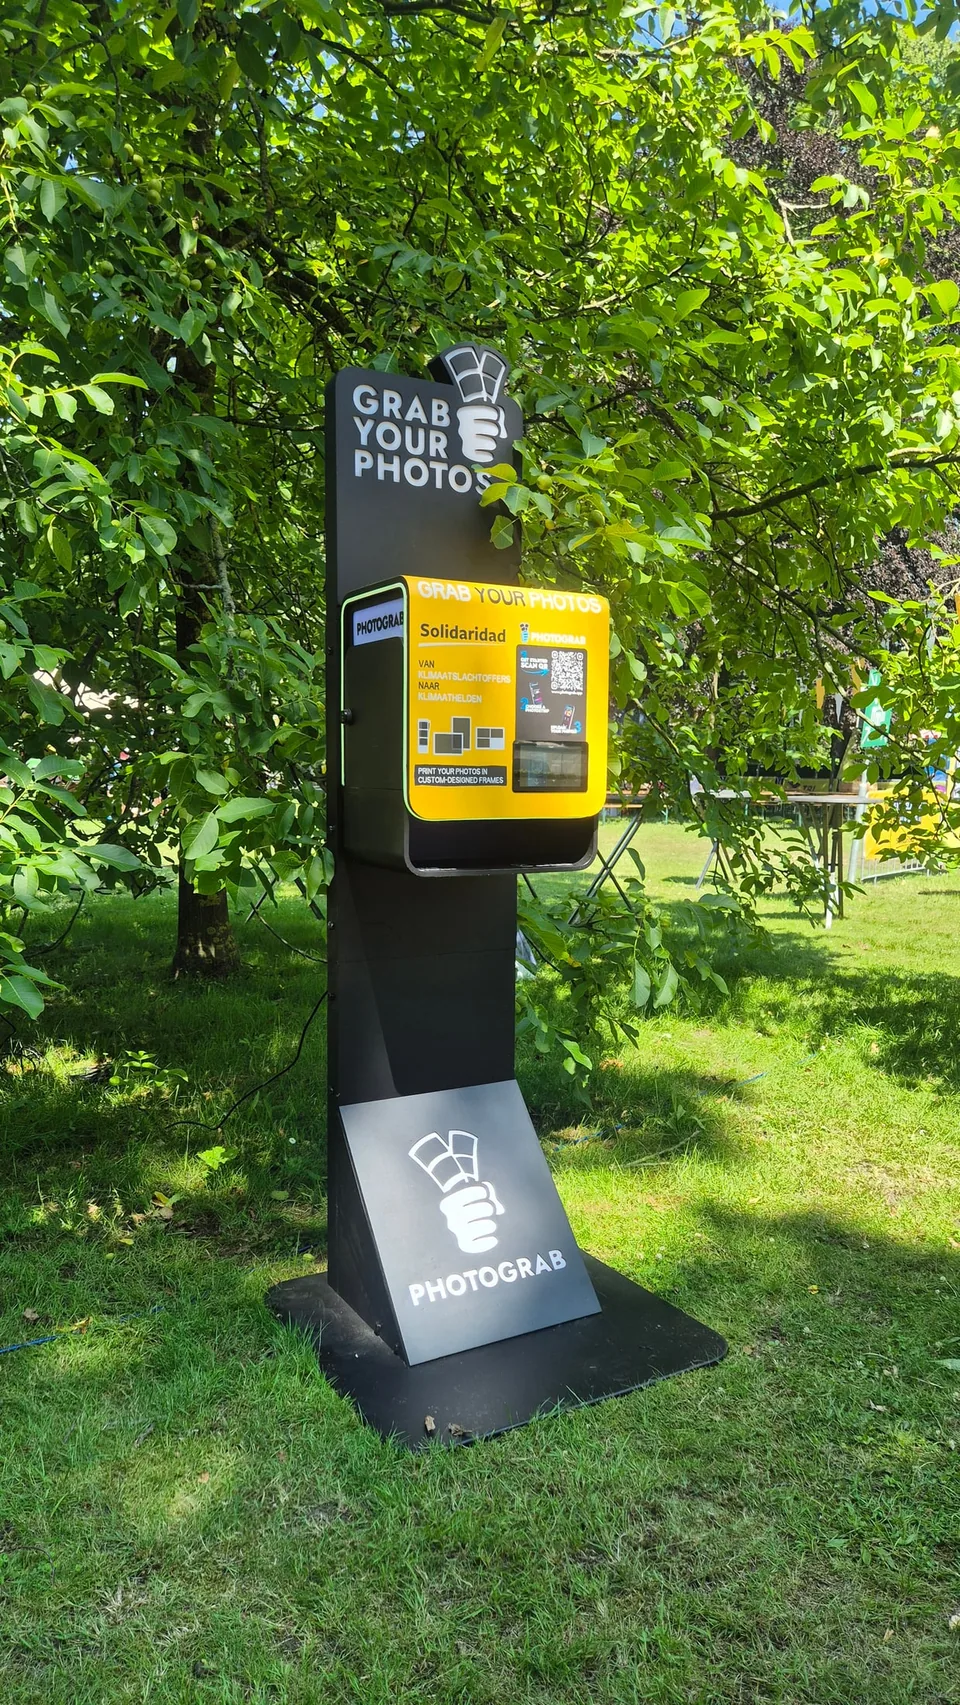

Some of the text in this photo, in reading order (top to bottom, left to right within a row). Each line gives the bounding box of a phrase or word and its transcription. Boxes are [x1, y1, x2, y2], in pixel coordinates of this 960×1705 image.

[353, 384, 451, 428] GRAB
[353, 416, 448, 459] YOUR
[354, 449, 492, 496] PHOTOS
[417, 580, 602, 614] GRAB YOUR PHOTOS
[420, 623, 506, 643] Solidaridad
[530, 632, 586, 645] PHOTOGRAB
[418, 659, 435, 669] VAN
[417, 671, 511, 684] KLIMAATSLACHTOFFERS
[418, 681, 440, 690] NAAR
[417, 692, 482, 704] KLIMAATHELDEN
[417, 767, 437, 775] PRINT
[437, 767, 455, 775] YOUR
[481, 768, 488, 776] IN
[417, 776, 478, 784] CUSTOM-DESIGNED
[408, 1249, 567, 1306] PHOTOGRAB
